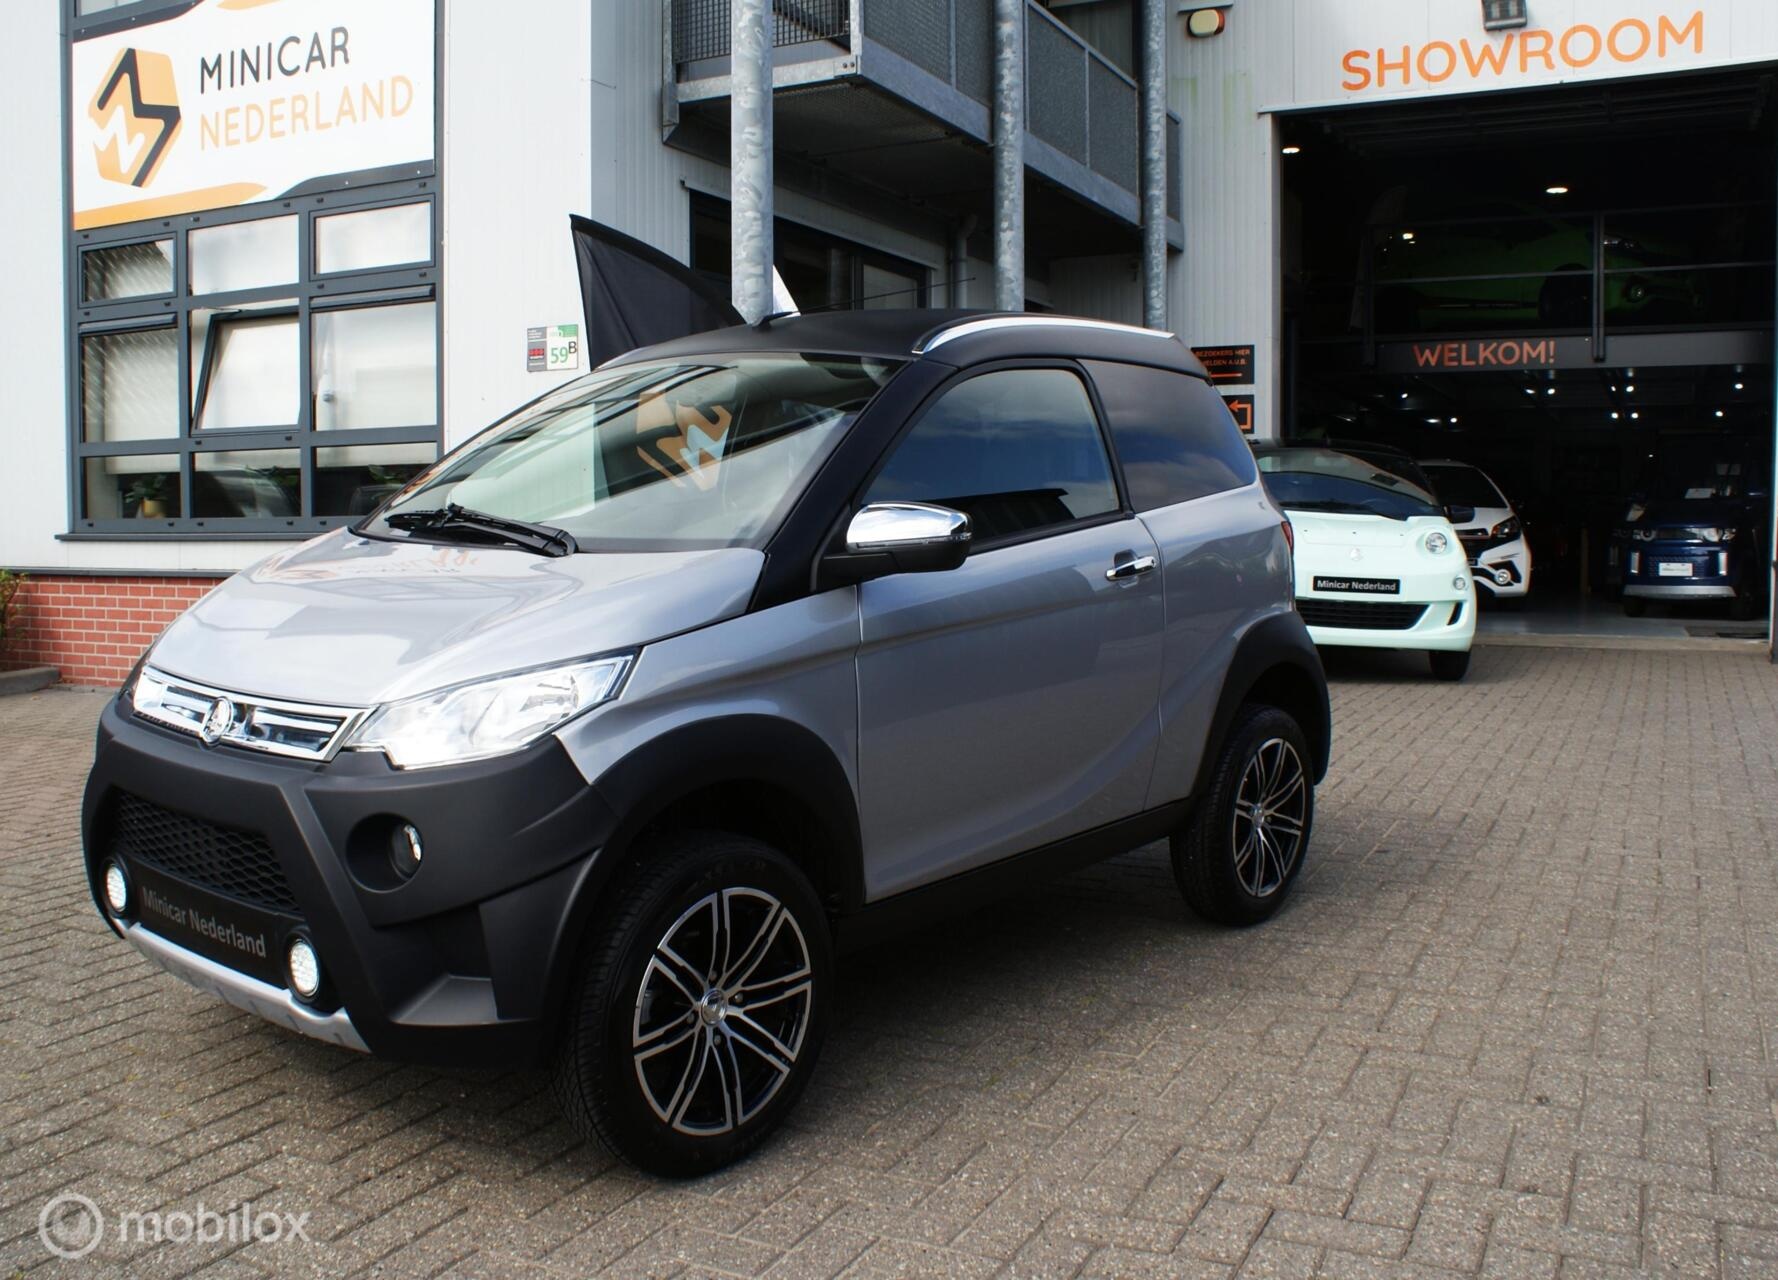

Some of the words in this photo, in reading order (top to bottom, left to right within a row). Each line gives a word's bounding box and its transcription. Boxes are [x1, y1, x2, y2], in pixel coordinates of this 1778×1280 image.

[200, 26, 350, 94] MINICAR
[1341, 11, 1704, 91] SHOWROOM
[200, 75, 414, 151] NEDERLAND
[1412, 338, 1556, 367] WELKOM!
[1317, 579, 1349, 589] Minicar
[1351, 581, 1396, 591] Nederland
[142, 885, 188, 925] Minicar
[188, 910, 267, 958] Nederland
